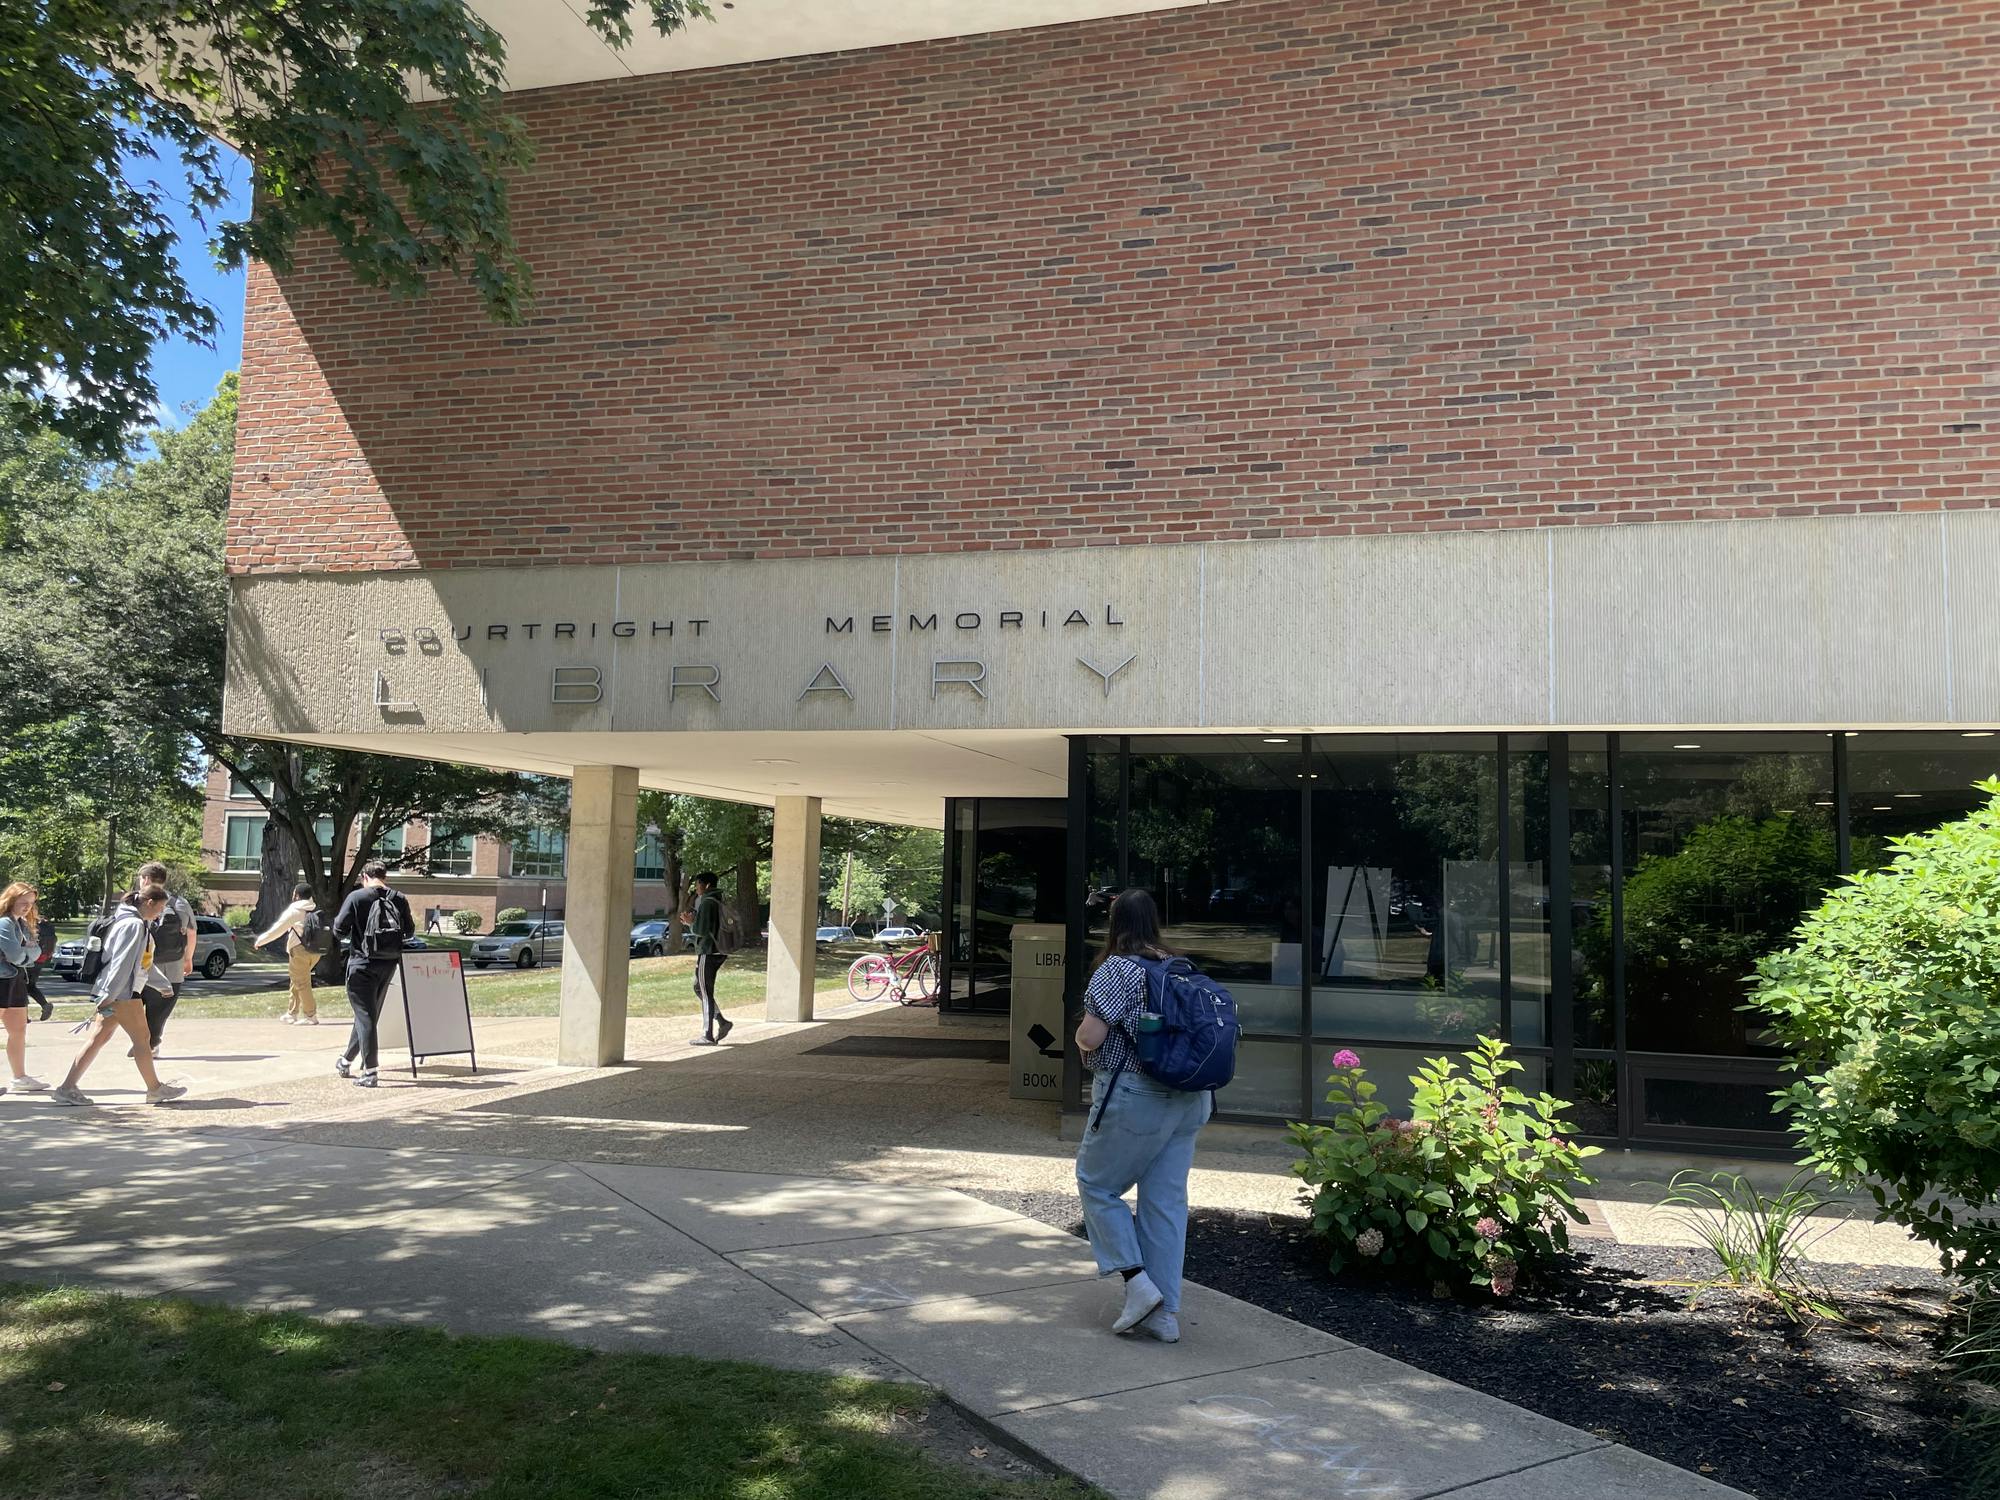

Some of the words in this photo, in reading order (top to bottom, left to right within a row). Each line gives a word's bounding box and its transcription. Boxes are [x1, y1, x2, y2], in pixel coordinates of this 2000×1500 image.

[380, 619, 709, 644] COURTRIGHT
[826, 604, 1124, 634] MEMORIAL
[374, 654, 1137, 706] LIBRARY
[1023, 1073, 1057, 1088] BOOK
